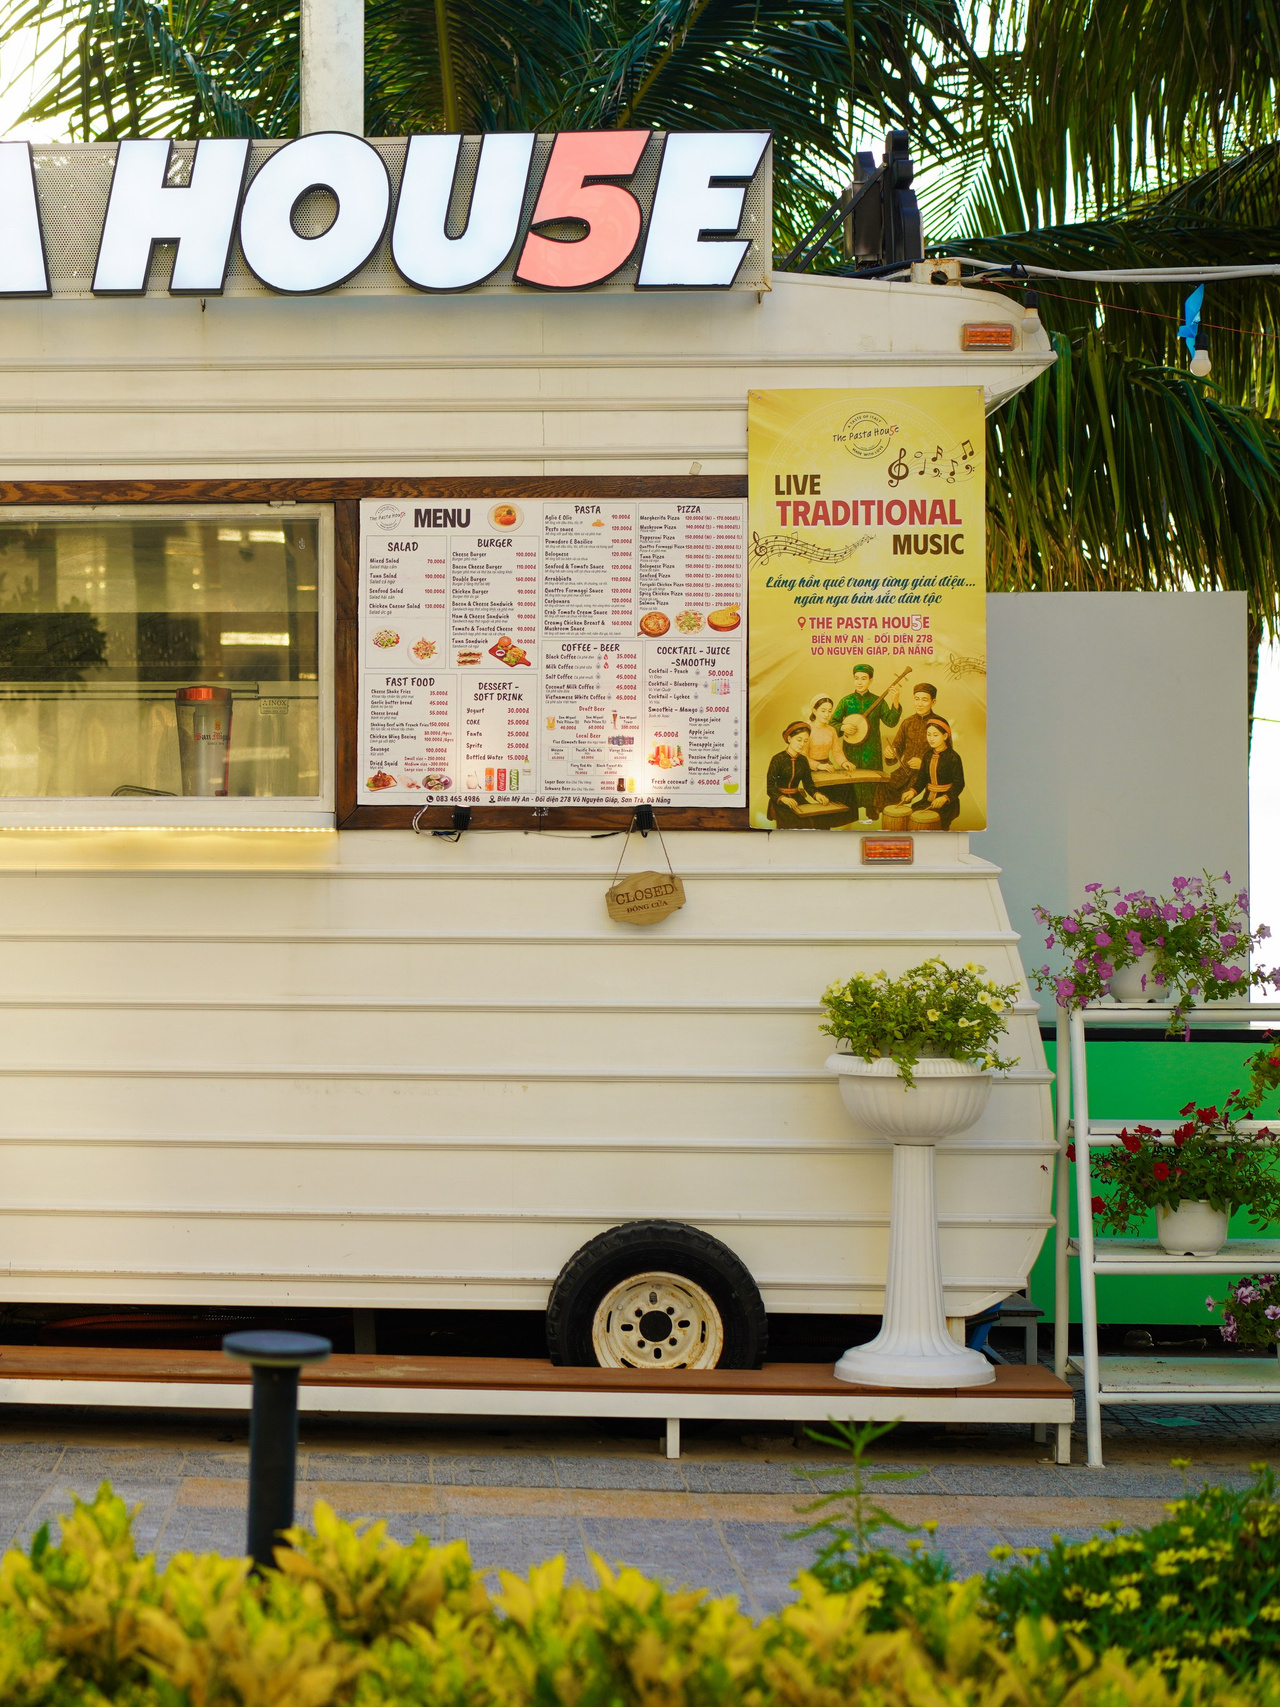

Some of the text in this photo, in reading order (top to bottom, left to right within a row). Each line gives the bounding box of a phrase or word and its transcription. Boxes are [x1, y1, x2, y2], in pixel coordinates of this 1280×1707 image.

[89, 127, 775, 298] HOU5E
[832, 434, 847, 443] The
[849, 430, 872, 441] Pasta
[775, 475, 821, 496] LIVE
[575, 505, 601, 514] PASTA
[677, 506, 701, 514] PIZZA
[775, 498, 964, 527] TRADITIONAL
[415, 509, 471, 528] MENU
[388, 542, 419, 552] SALAD
[478, 539, 513, 548] BURGER
[893, 534, 964, 555] MUSIC
[823, 577, 846, 593] quê
[846, 578, 878, 592] trong
[911, 577, 938, 590] giai
[794, 593, 825, 608] ngân
[826, 594, 850, 608] nga
[898, 592, 922, 605] dân
[809, 614, 930, 631] THE PASTA HOU5E
[851, 635, 864, 644] AN
[916, 635, 933, 644] 278
[562, 643, 591, 652] COFFEE
[601, 644, 620, 652] BEER
[657, 646, 697, 655] COCKTAIL
[706, 647, 730, 655] JUICE
[672, 658, 716, 668] -SMOOTHY
[386, 677, 435, 687] FAST FOOD
[479, 682, 513, 691] DESSERT
[474, 693, 523, 702] SOFT DRINK
[616, 884, 674, 905] CLOSED
